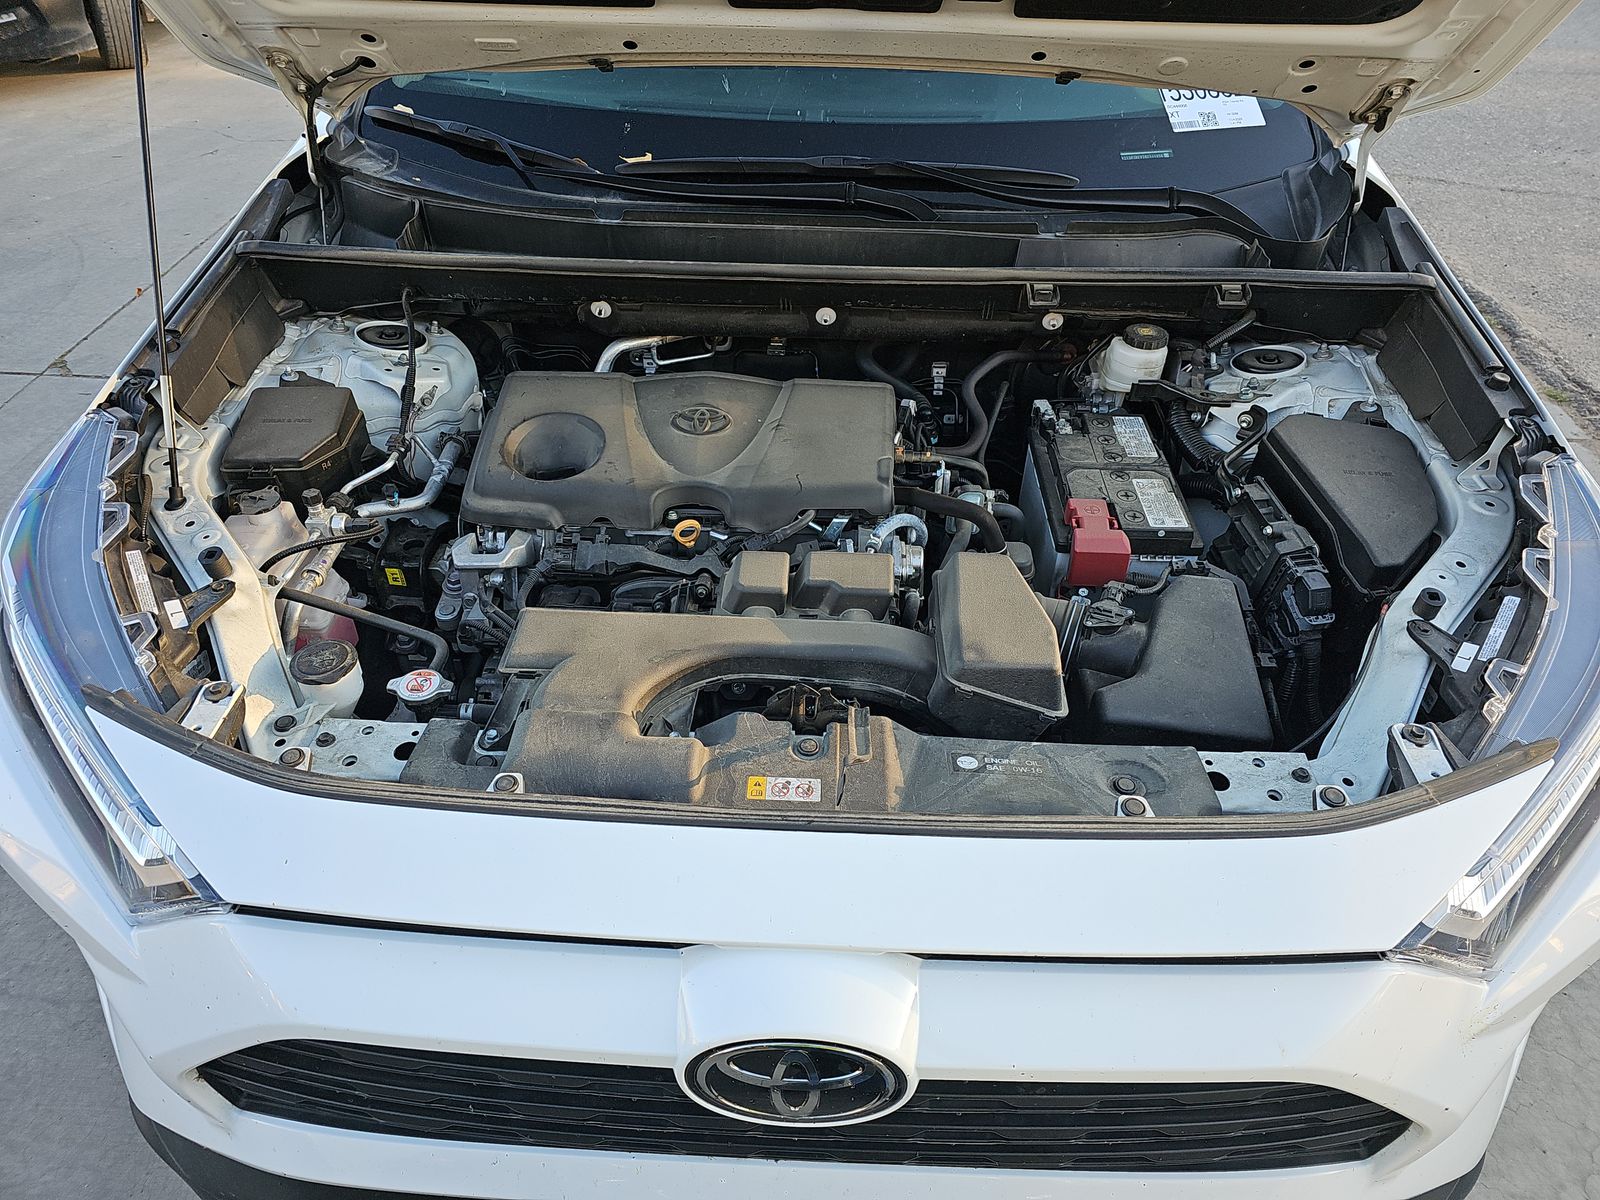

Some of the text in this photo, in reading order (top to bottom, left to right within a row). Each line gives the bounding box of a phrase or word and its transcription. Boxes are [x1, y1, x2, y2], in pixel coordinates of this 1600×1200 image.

[1168, 110, 1180, 118] XT
[321, 460, 333, 472] R4
[984, 757, 1018, 765] ENGINE
[1012, 766, 1043, 774] 0W-16
